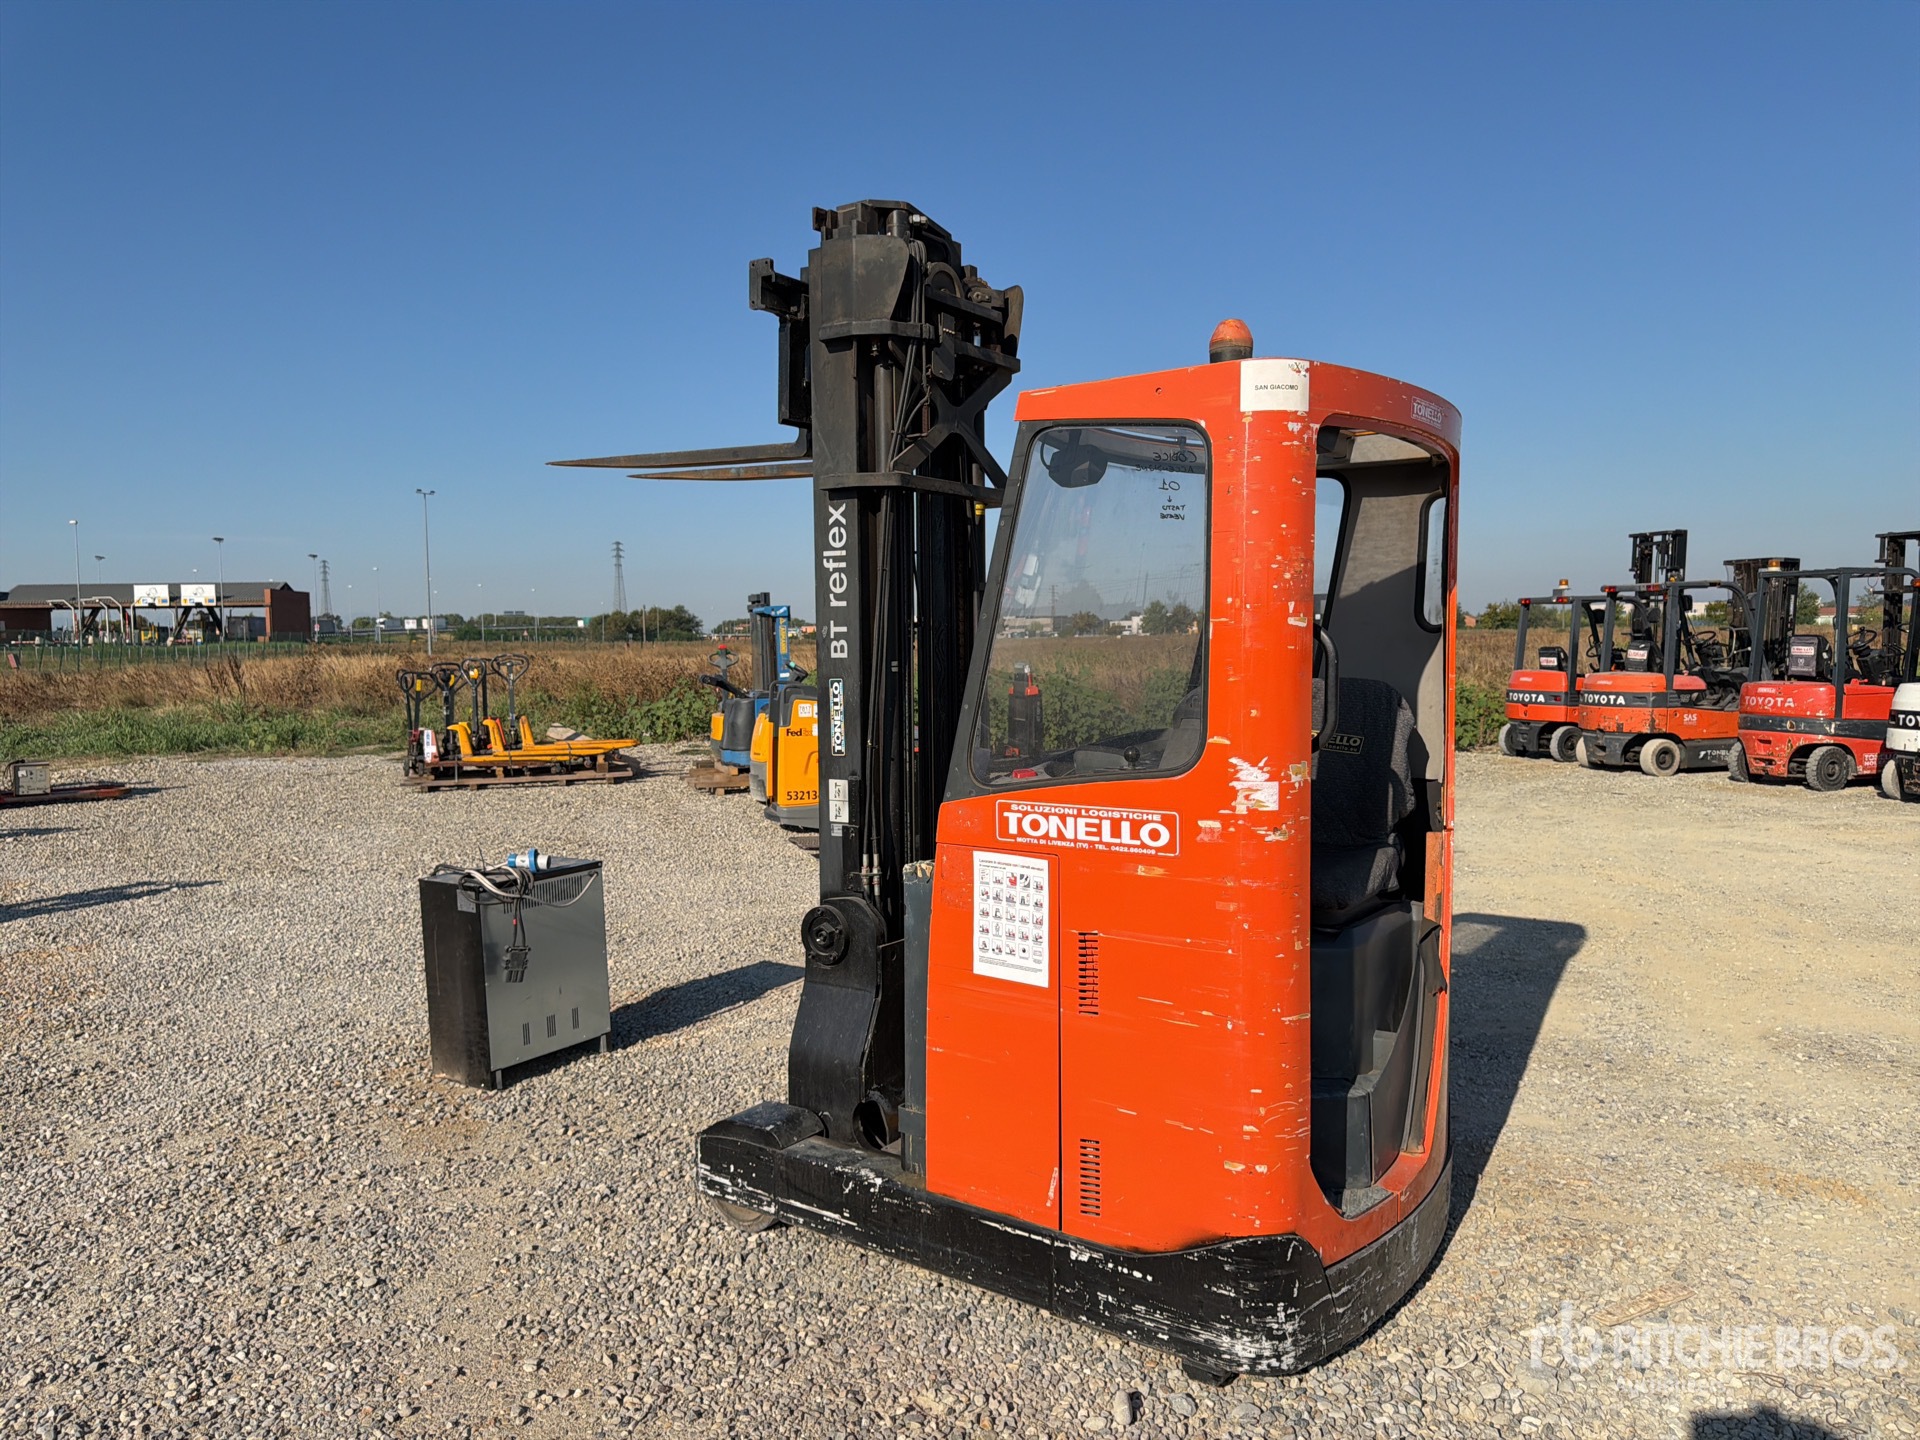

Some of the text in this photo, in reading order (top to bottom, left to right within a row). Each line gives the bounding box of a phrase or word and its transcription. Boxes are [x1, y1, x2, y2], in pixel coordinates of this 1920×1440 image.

[1413, 402, 1442, 424] TONELLO
[823, 503, 848, 658] BT reflex
[1509, 692, 1545, 703] TOYOTA
[1584, 694, 1625, 705] TOYOTA
[1745, 696, 1795, 708] TOYOTA
[833, 681, 844, 753] TONELLO
[1683, 713, 1697, 722] SAS
[787, 790, 819, 800] 53213
[1010, 803, 1162, 821] SOLUZIONI LOGISTICHE
[1003, 811, 1170, 847] TONELLO
